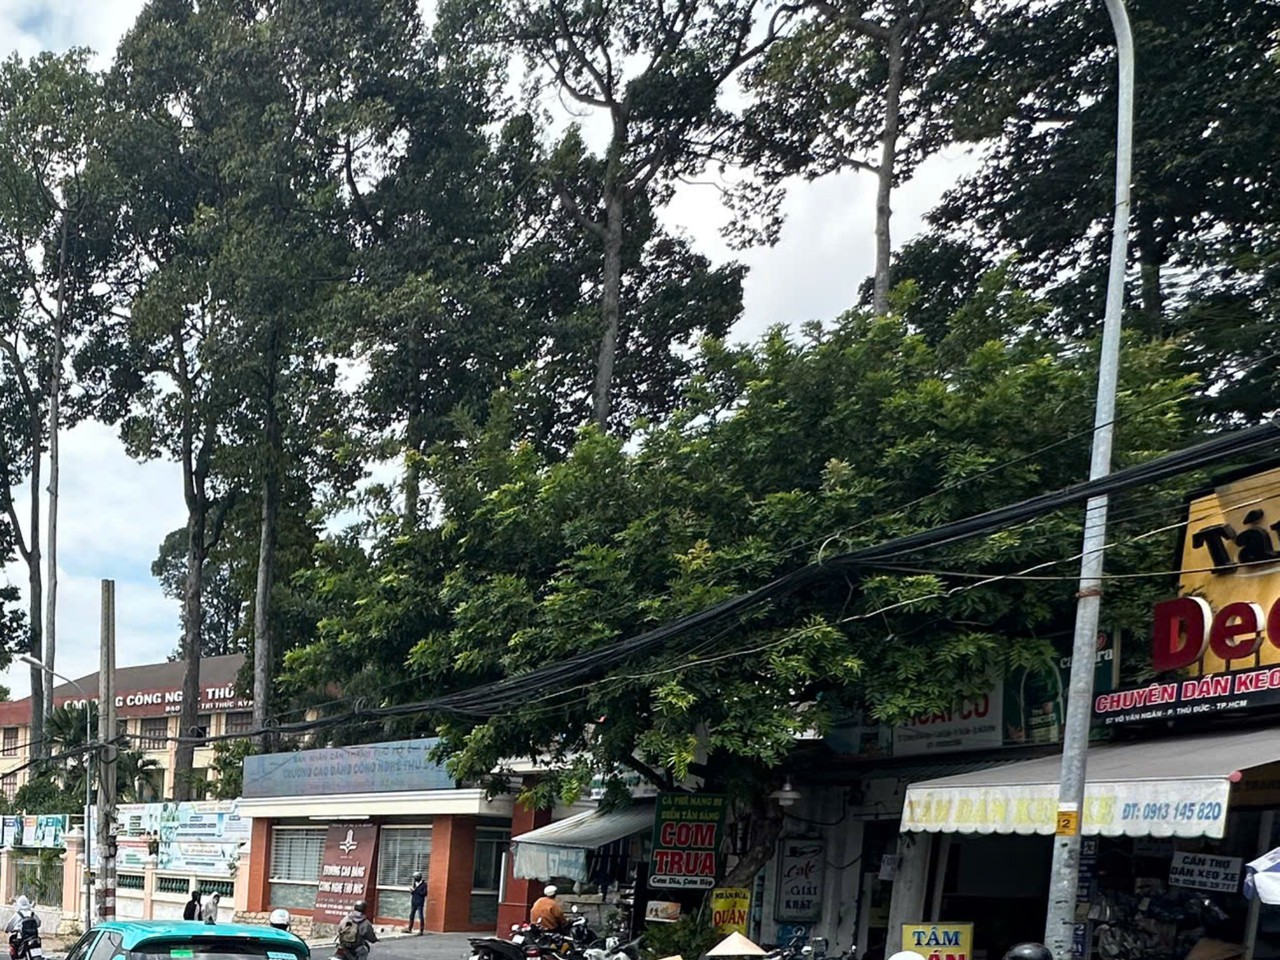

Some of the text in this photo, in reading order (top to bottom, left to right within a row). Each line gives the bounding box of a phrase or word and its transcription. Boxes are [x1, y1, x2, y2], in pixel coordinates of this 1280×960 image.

[1192, 508, 1280, 575] Tâ
[1154, 596, 1280, 672] De
[126, 691, 161, 706] CÔNG
[206, 682, 235, 699] THỦ
[1095, 682, 1177, 713] CHUYÊN
[1181, 673, 1232, 700] DÁN
[1176, 705, 1192, 714] THỦ
[1122, 802, 1221, 820] ĐT: 0913 145 820
[661, 821, 717, 848] CƠM
[654, 850, 716, 876] TRƯA
